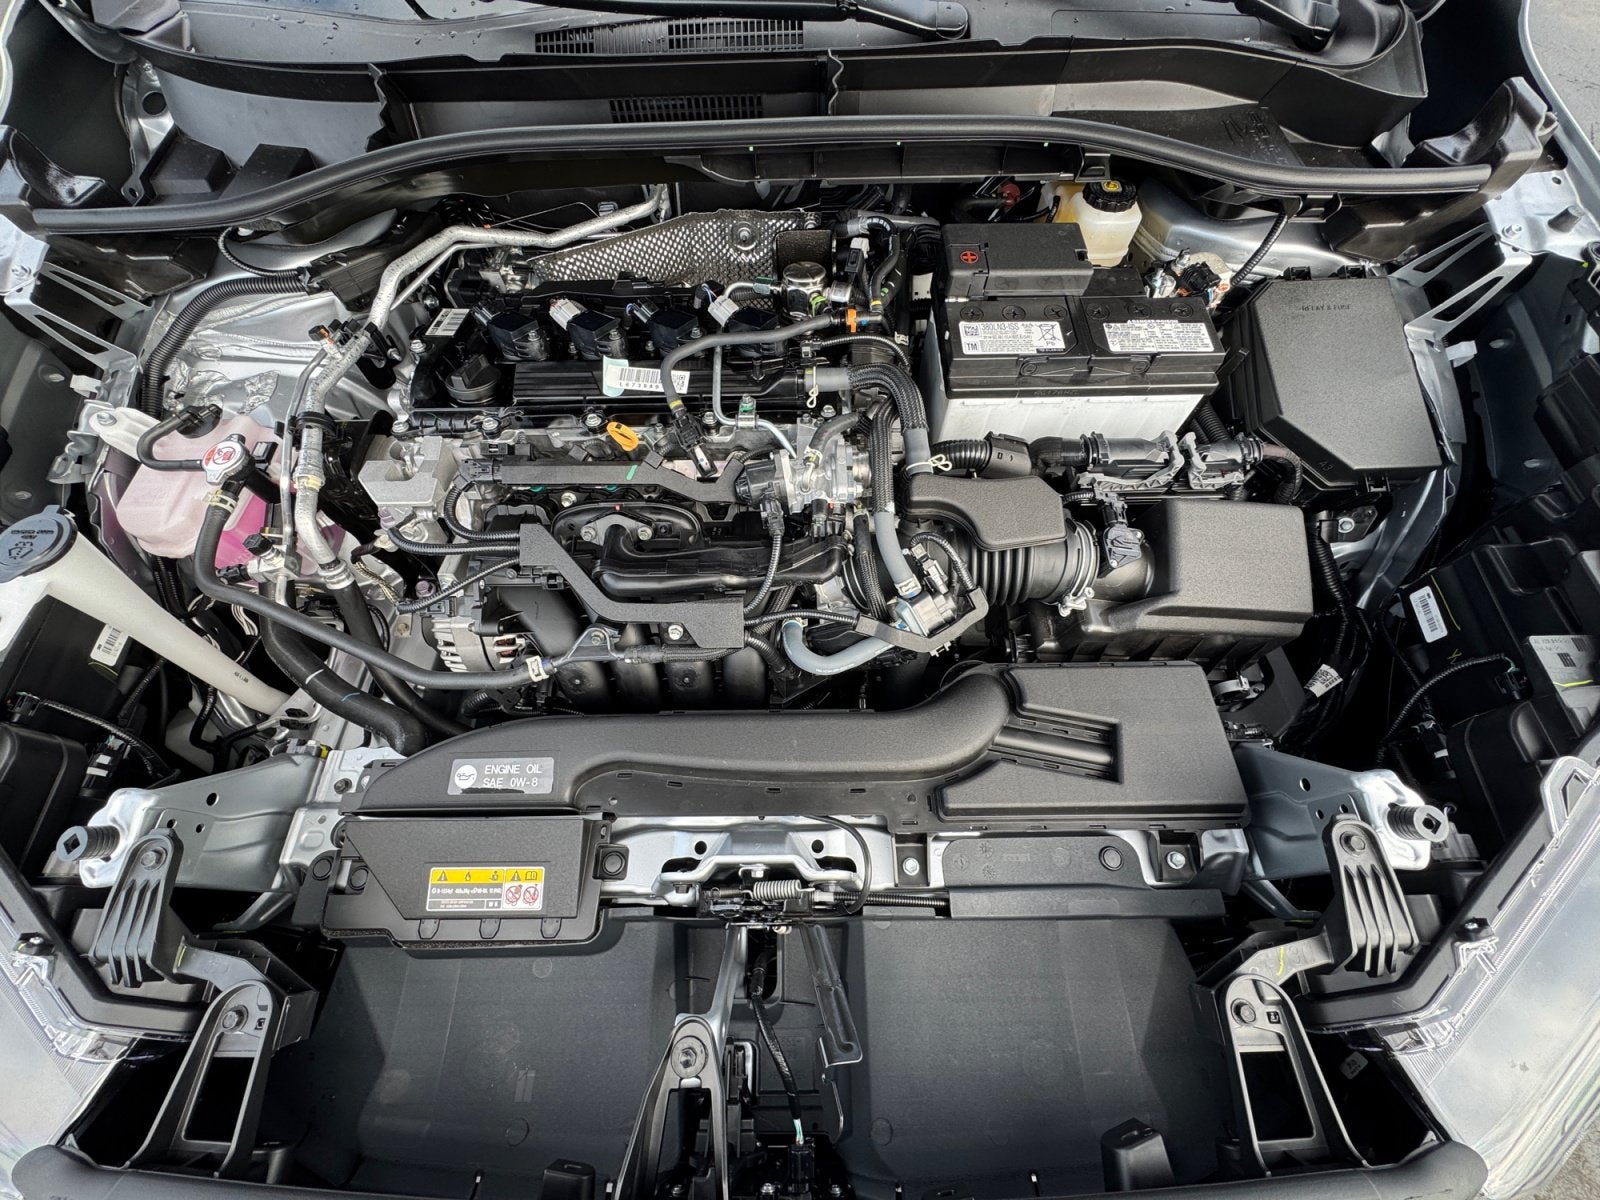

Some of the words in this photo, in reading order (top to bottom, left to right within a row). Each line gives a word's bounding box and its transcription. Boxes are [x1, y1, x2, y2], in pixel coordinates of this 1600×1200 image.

[966, 342, 978, 351] TM
[484, 764, 521, 775] ENGINE
[526, 763, 543, 774] OIL
[483, 777, 504, 788] SAE
[510, 777, 538, 788] 0W-8
